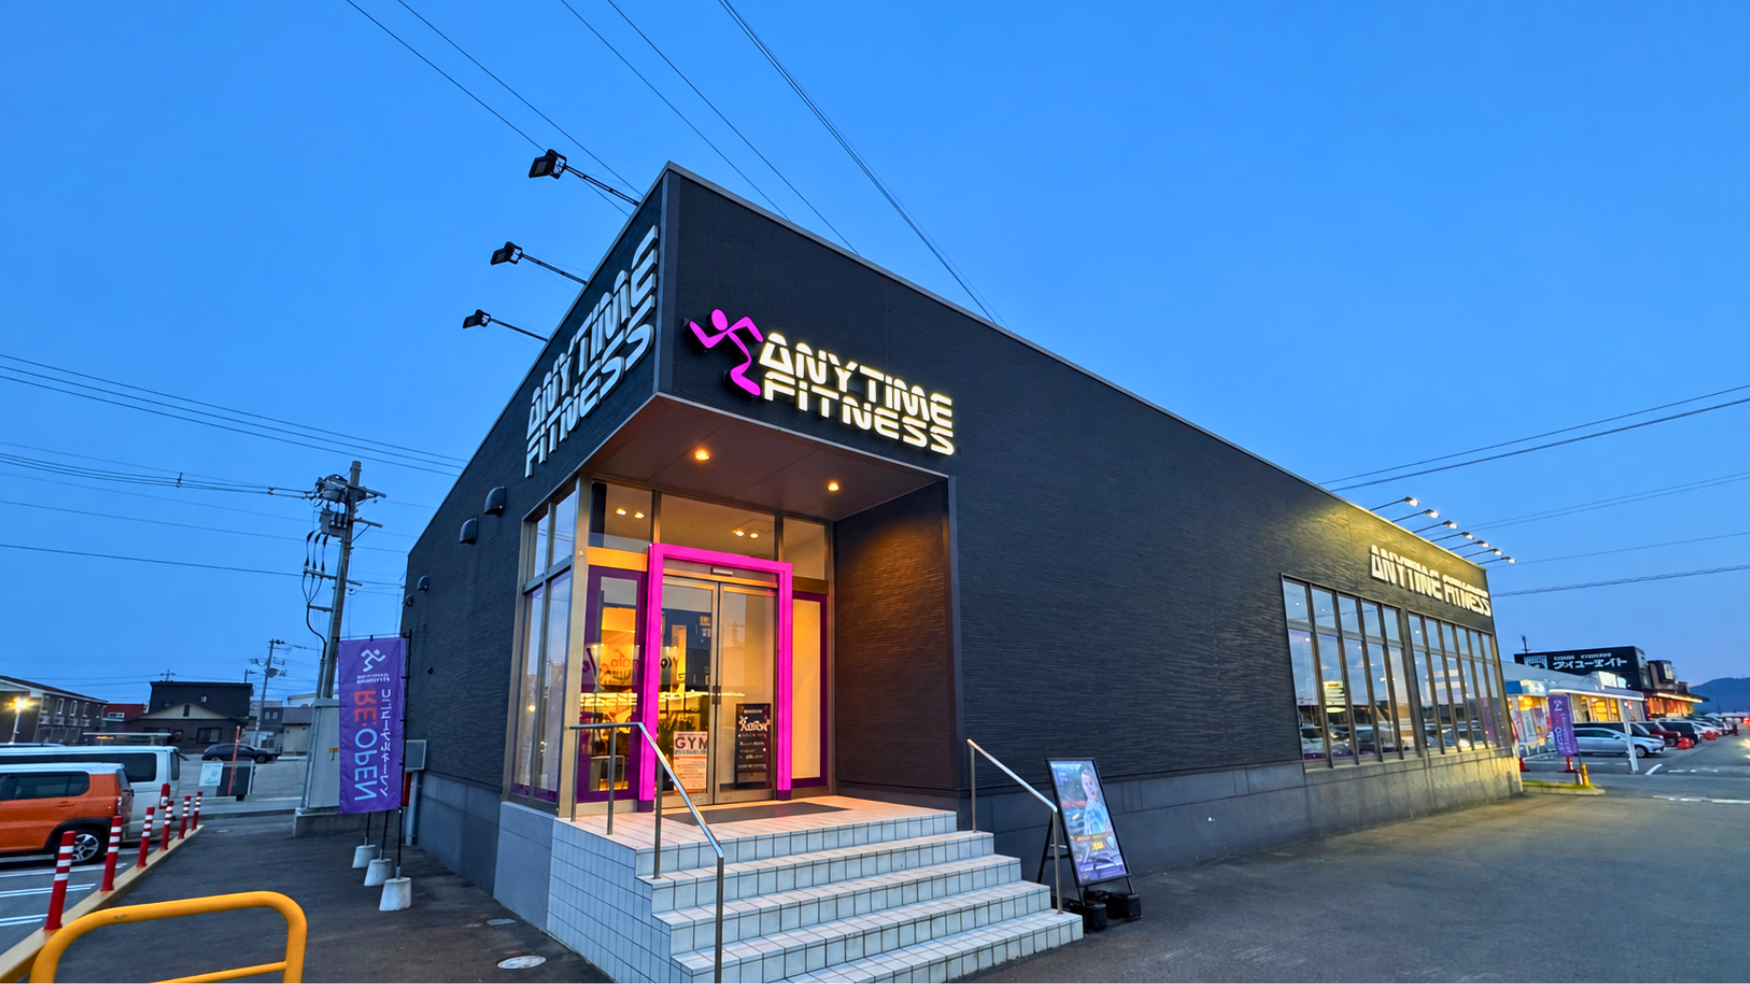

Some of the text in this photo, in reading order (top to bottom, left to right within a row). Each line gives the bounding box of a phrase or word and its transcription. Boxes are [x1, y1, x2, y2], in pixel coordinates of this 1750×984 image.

[526, 225, 658, 441] ANYTIME
[524, 295, 655, 478] FITNESS
[758, 332, 953, 428] ANYTIME
[763, 371, 955, 456] FITNESS
[1370, 544, 1492, 617] ANYTIME FITNESS
[675, 736, 708, 750] GYM
